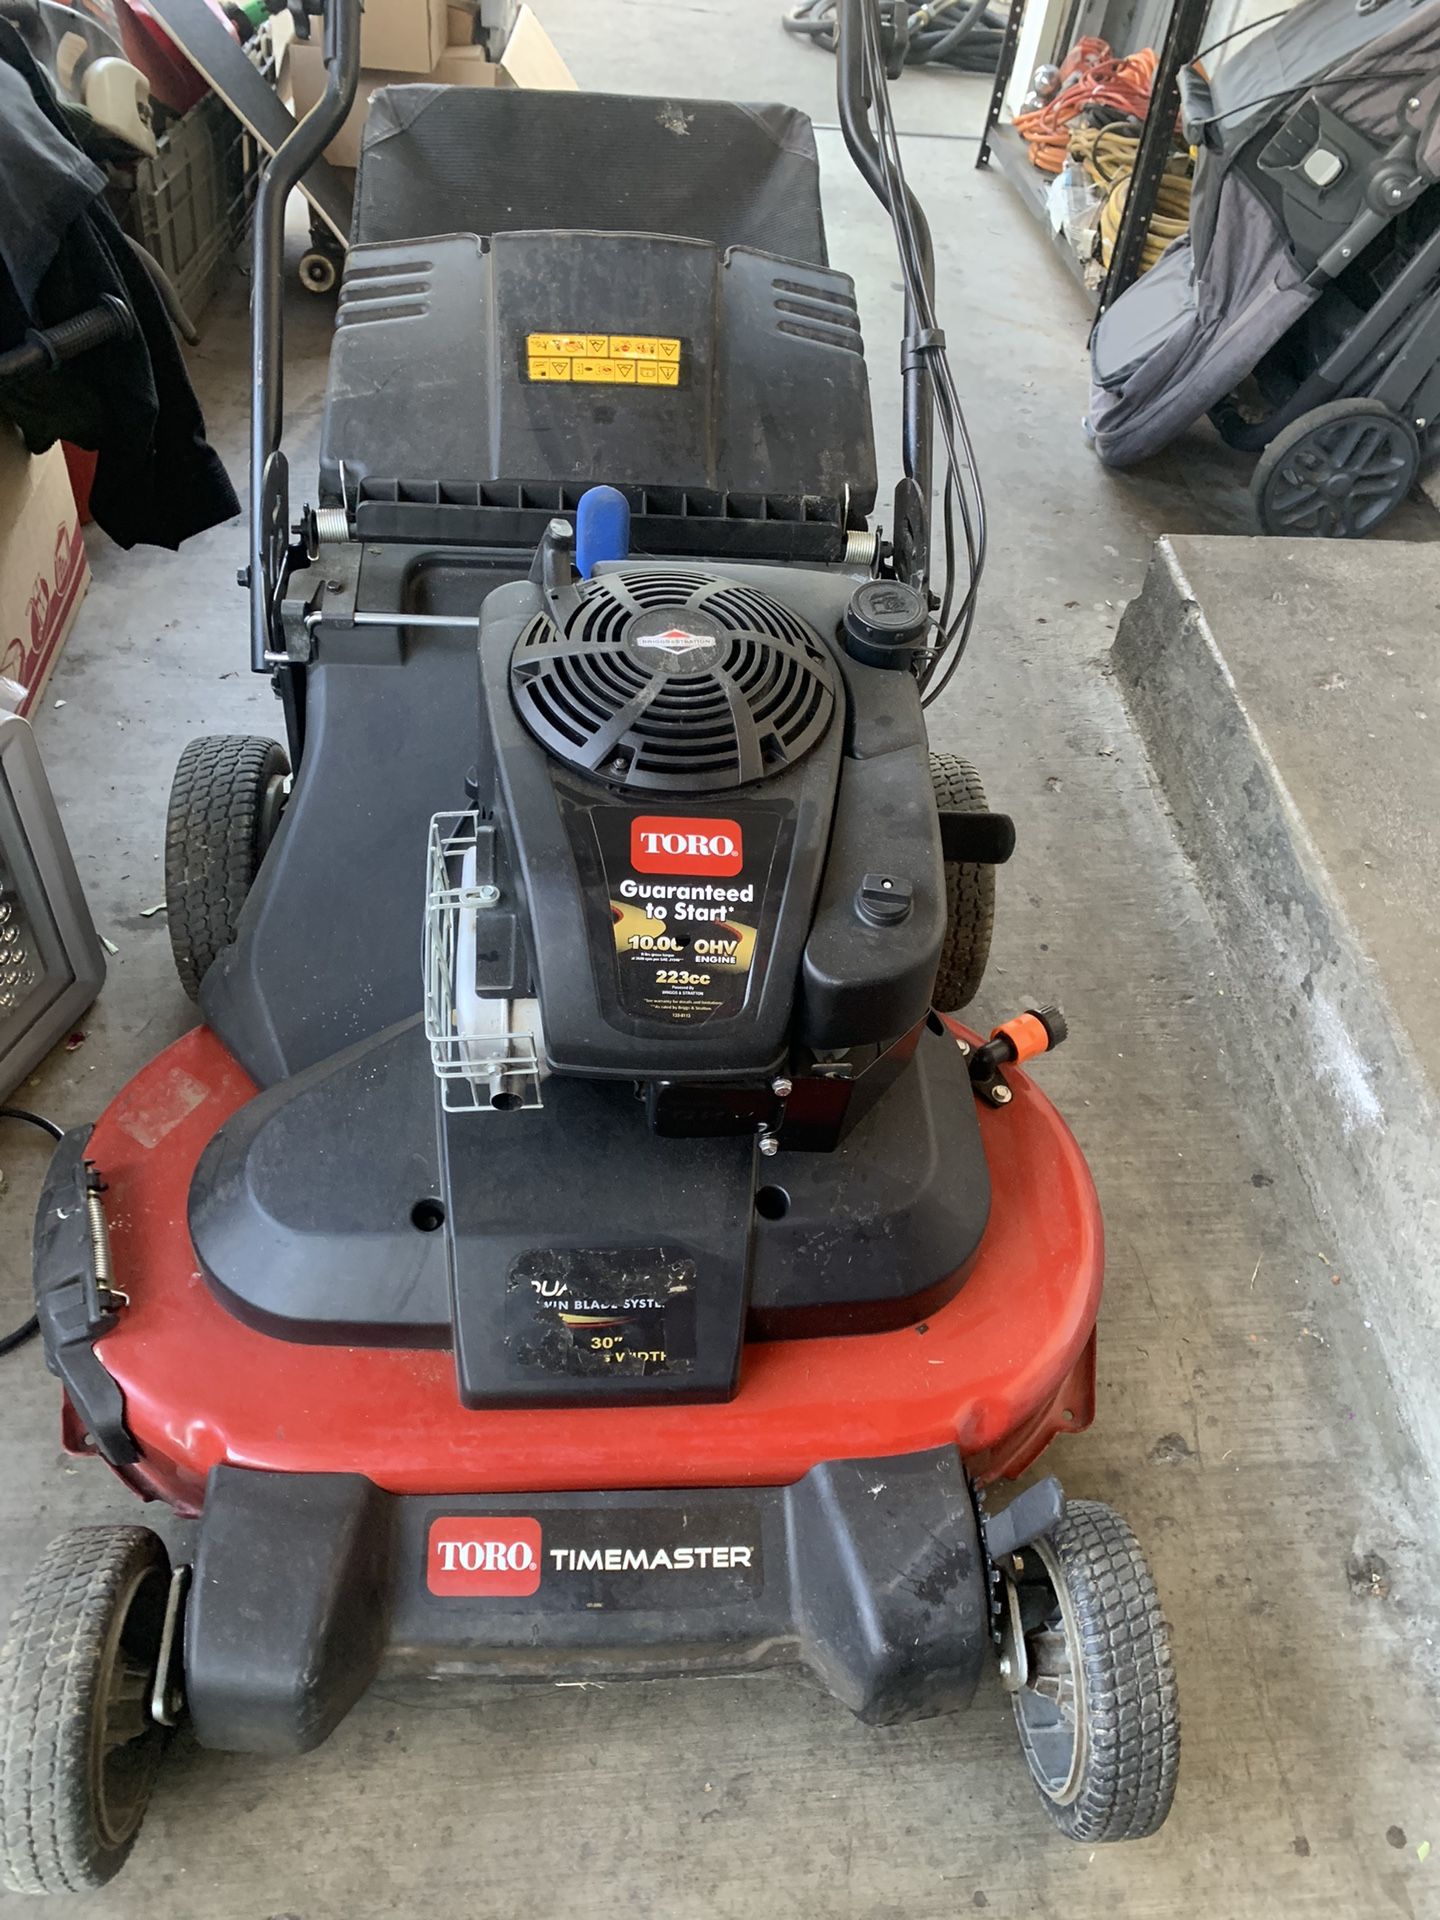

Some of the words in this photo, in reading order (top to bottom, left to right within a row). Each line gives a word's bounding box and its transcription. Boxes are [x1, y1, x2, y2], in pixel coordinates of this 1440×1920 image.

[640, 832, 734, 856] TORO
[620, 880, 754, 902] Guaranteed
[645, 903, 668, 920] to
[694, 939, 738, 956] OHV
[695, 956, 736, 964] ENGINE
[655, 970, 711, 985] 223cc
[437, 1541, 533, 1571] TORO
[550, 1546, 752, 1571] TIMEMASTER
